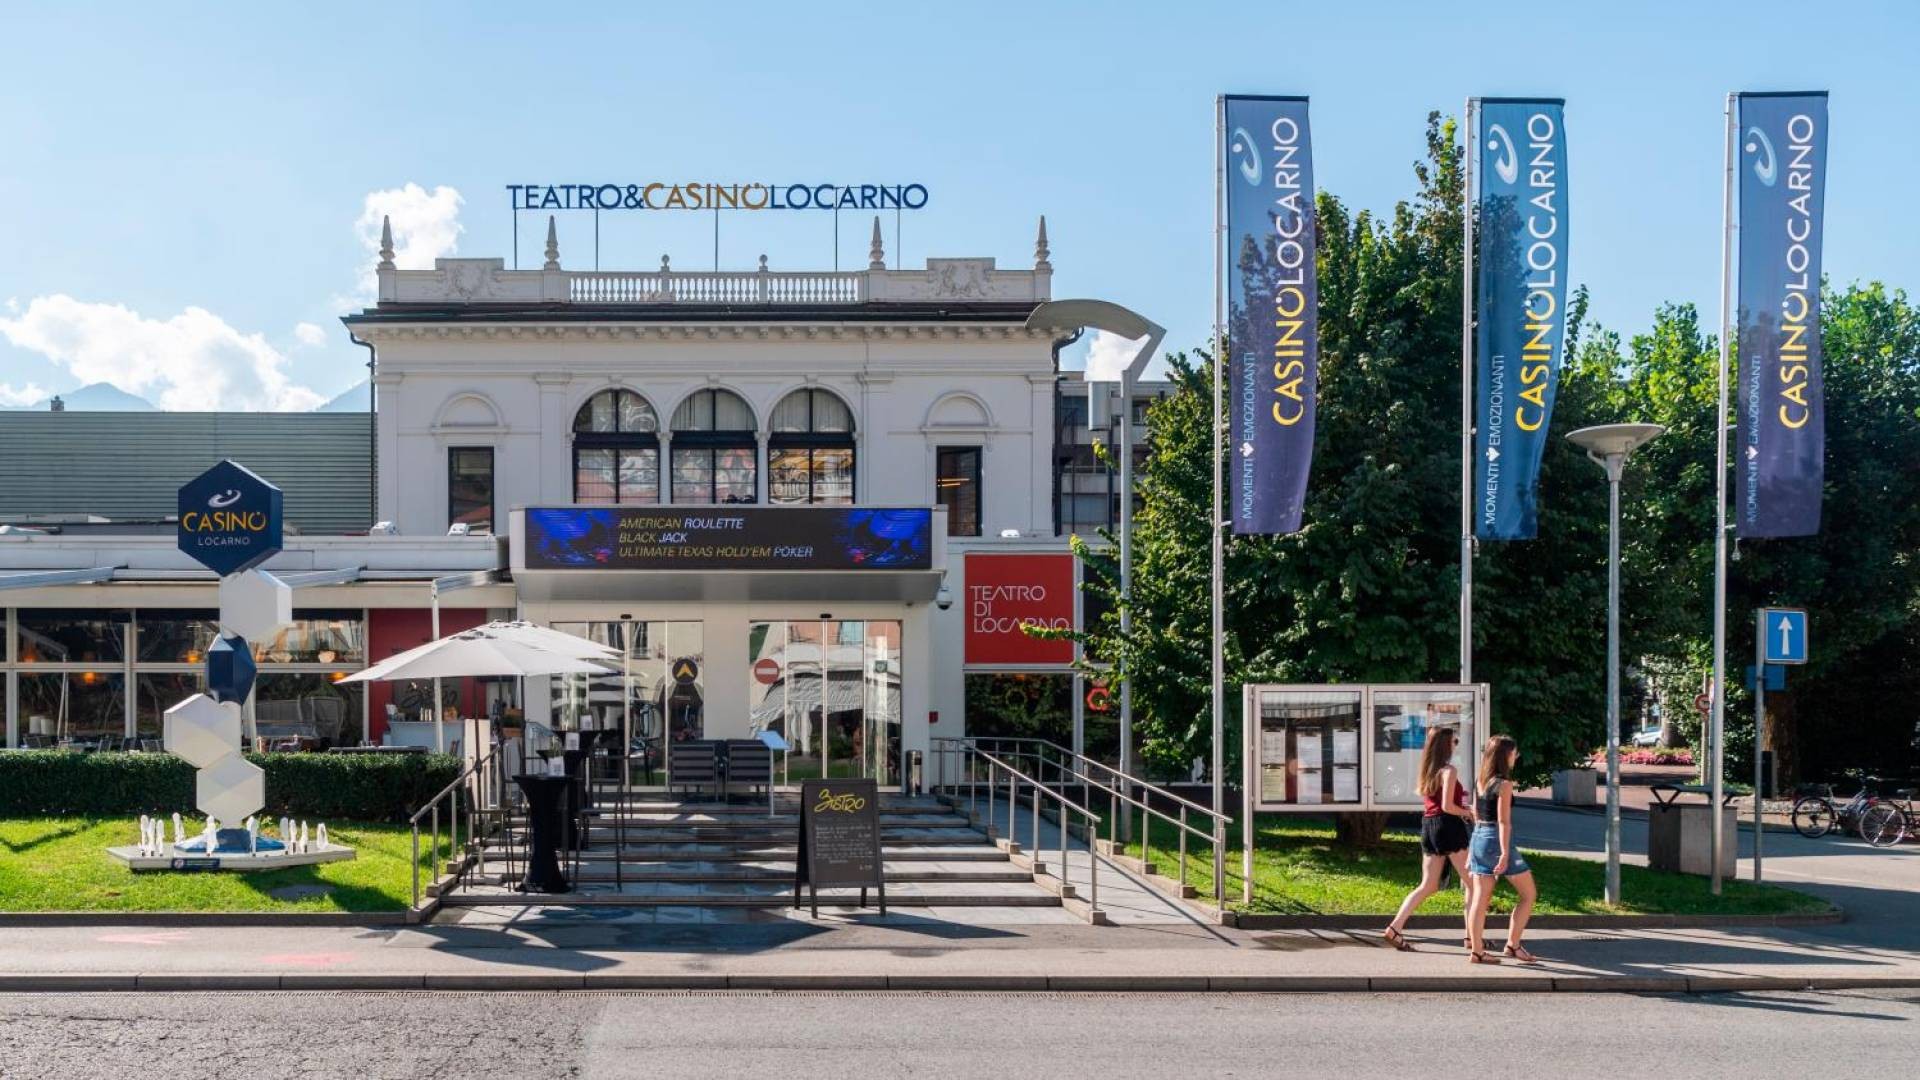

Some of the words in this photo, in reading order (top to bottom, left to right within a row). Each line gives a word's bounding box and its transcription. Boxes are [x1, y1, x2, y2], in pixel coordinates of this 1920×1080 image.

[1243, 352, 1255, 441] EMOZIONANTI
[1489, 355, 1505, 446] EMOZIONANTI
[1748, 355, 1762, 445] EMOZIONANTI
[1241, 458, 1254, 519] MOMENTI
[1485, 463, 1500, 525] MOMENTI
[1746, 461, 1760, 524] MOMENTI
[182, 511, 267, 532] CASINO
[619, 517, 682, 529] AMERICAN
[684, 517, 745, 529] ROULETTE
[198, 536, 251, 546] LOCARNO
[619, 532, 657, 543] BLACK
[658, 532, 688, 543] JACK
[619, 546, 675, 558] ULTIMATE
[679, 546, 714, 558] TEXAS
[716, 546, 771, 558] HOLD'EM
[773, 546, 814, 558] POKER
[970, 585, 1046, 601] TEATRO
[973, 601, 992, 617] DI
